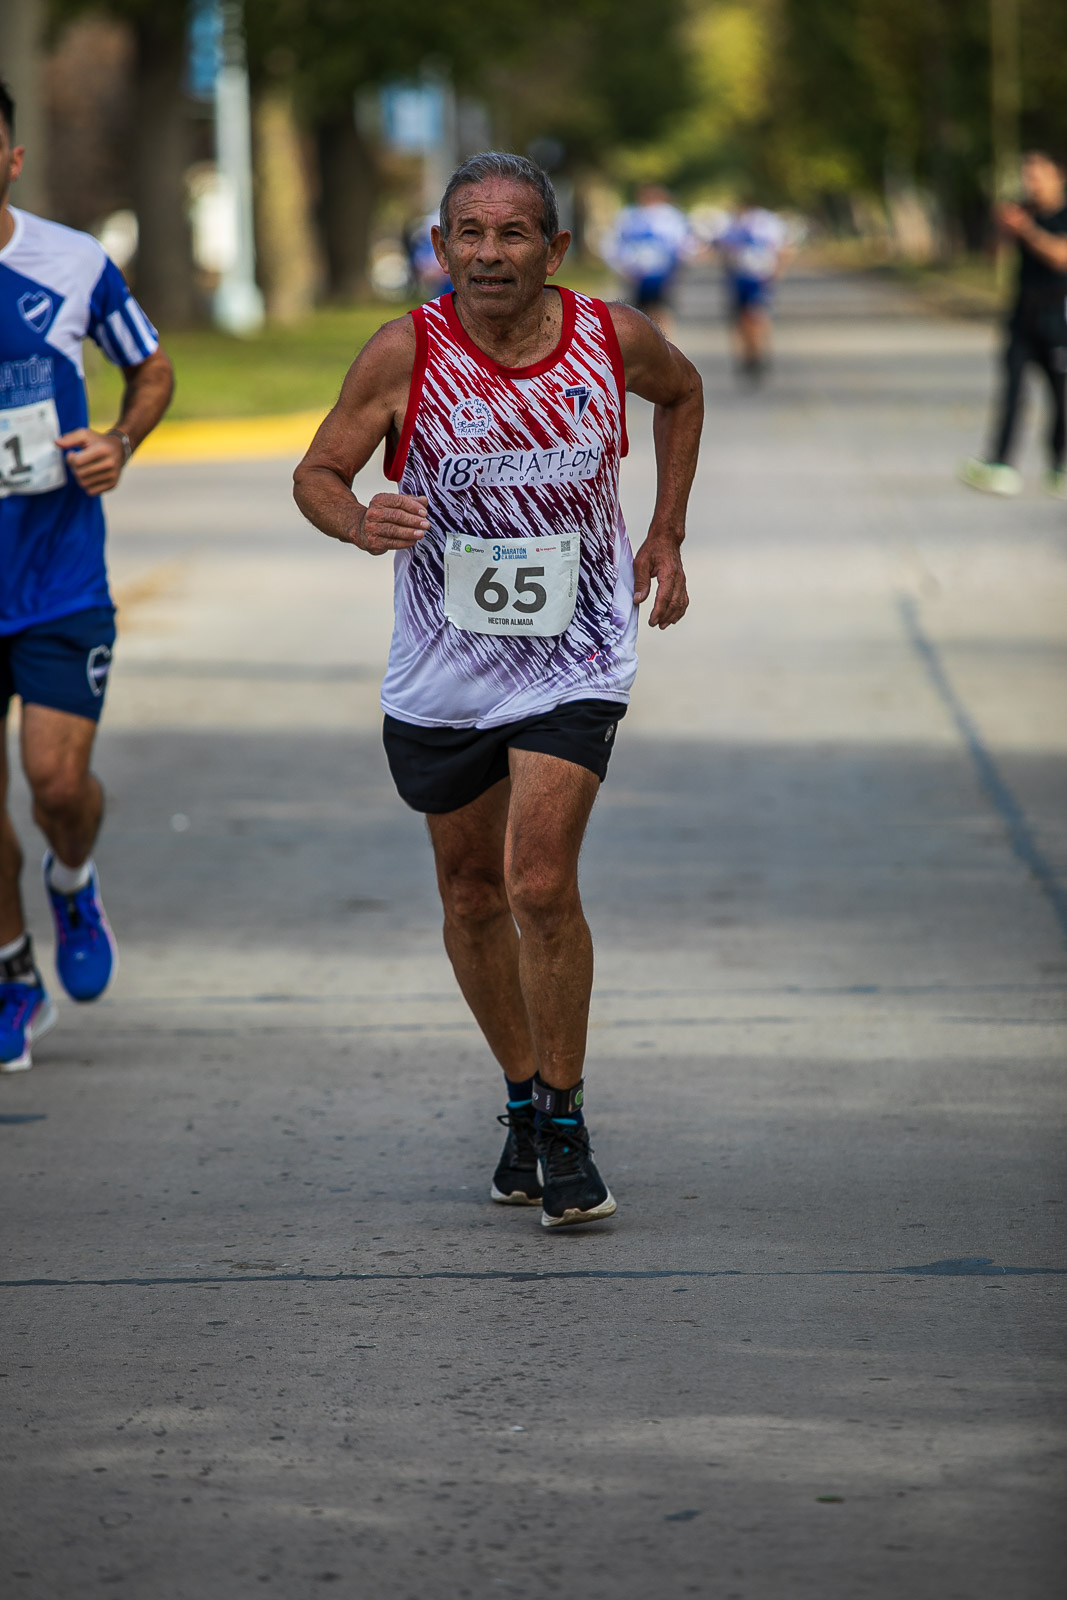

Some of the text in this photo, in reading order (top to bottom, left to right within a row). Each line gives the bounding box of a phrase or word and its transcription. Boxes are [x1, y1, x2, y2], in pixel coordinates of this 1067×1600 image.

[482, 446, 601, 478] TRIATLON
[480, 475, 525, 483] CLARO
[530, 474, 553, 482] que
[492, 545, 501, 562] 3
[501, 546, 527, 555] MARATÓN
[474, 566, 547, 614] 65
[488, 616, 534, 626] HECTOR ALMADA
